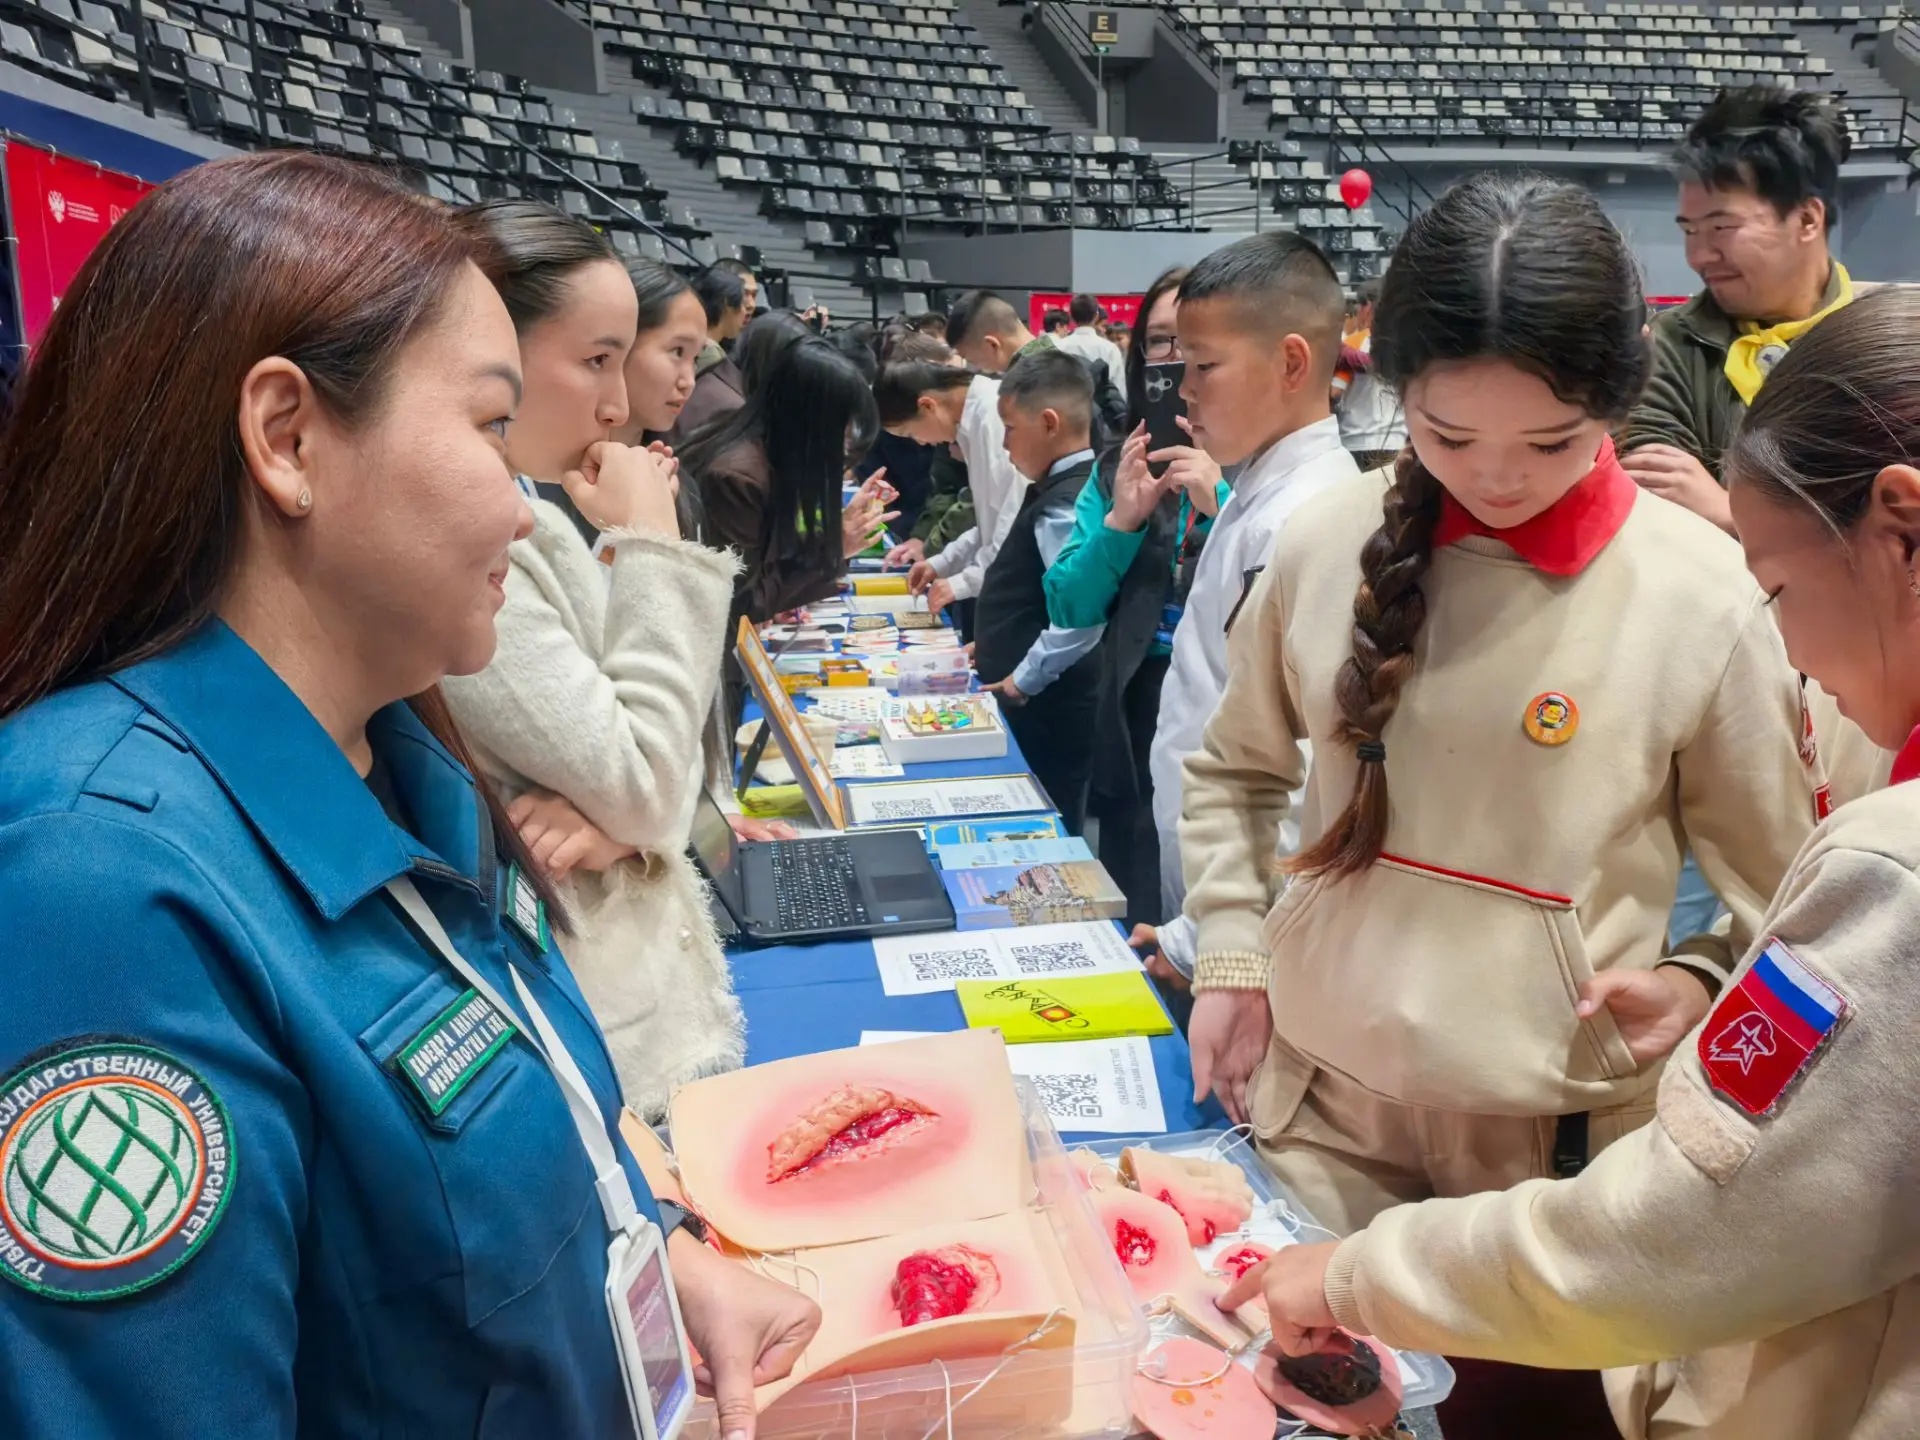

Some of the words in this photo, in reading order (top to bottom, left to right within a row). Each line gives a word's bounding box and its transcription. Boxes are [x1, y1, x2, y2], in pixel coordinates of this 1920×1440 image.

[408, 1028, 457, 1077] КАФЕДРА
[427, 1031, 487, 1096] ФИЗИОЛОГИИ
[479, 1024, 494, 1043] И
[179, 1092, 227, 1246] УНИВЕРСИТЕТ
